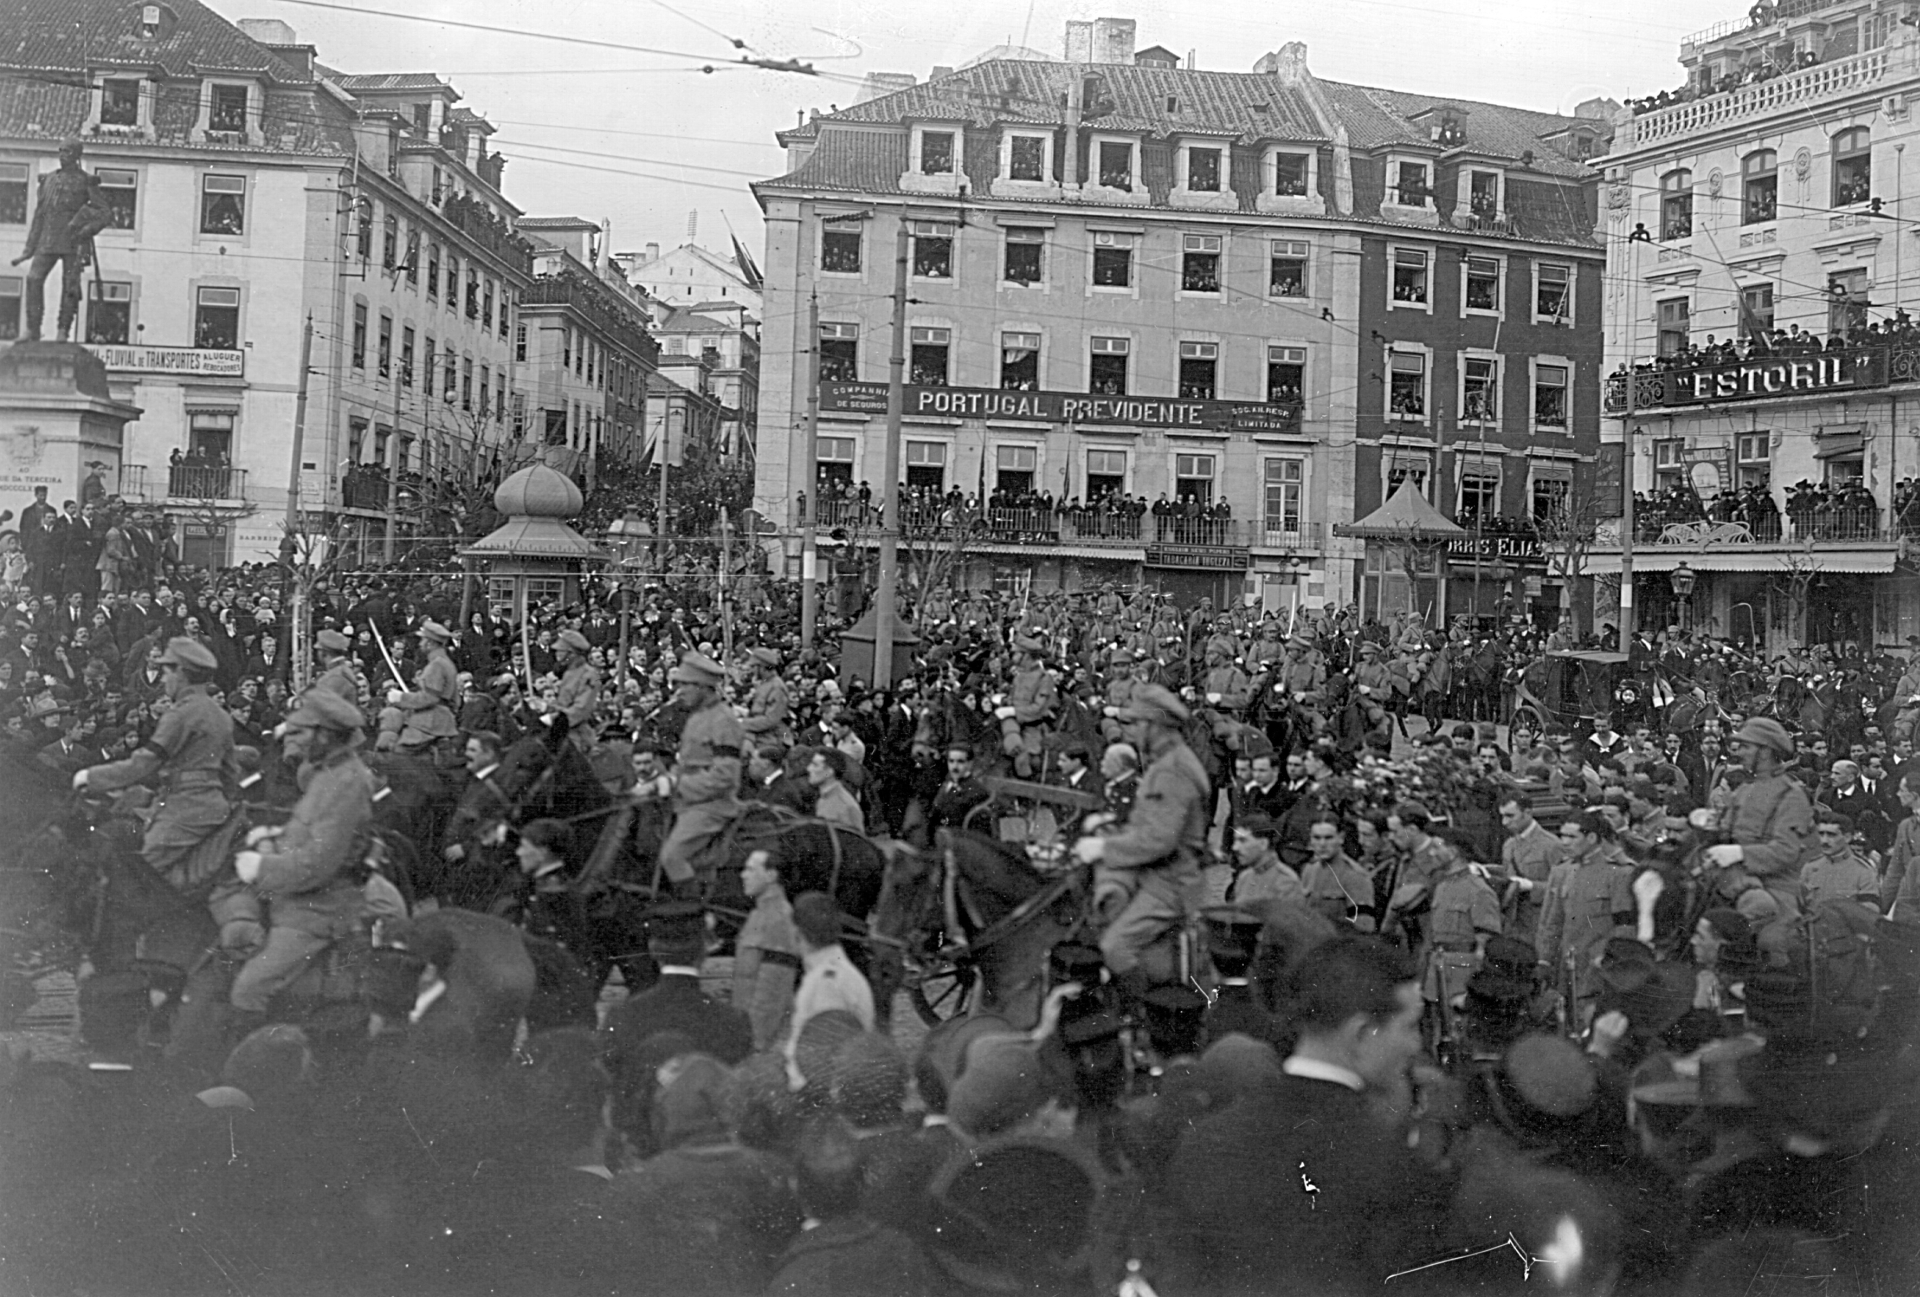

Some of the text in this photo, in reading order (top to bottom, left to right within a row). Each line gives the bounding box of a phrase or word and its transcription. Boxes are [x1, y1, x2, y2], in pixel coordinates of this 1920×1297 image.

[106, 349, 136, 366] FLUVIAL
[146, 351, 201, 369] TRANSPORTES
[203, 353, 241, 362] ALUGUER
[203, 362, 241, 372] REBOCADORES
[837, 400, 887, 409] DE SEGUROS
[918, 391, 1204, 424] PORTUGAL PREVIDENTE
[1238, 420, 1281, 429] LIMITADA
[25, 476, 62, 484] TERCEIRA
